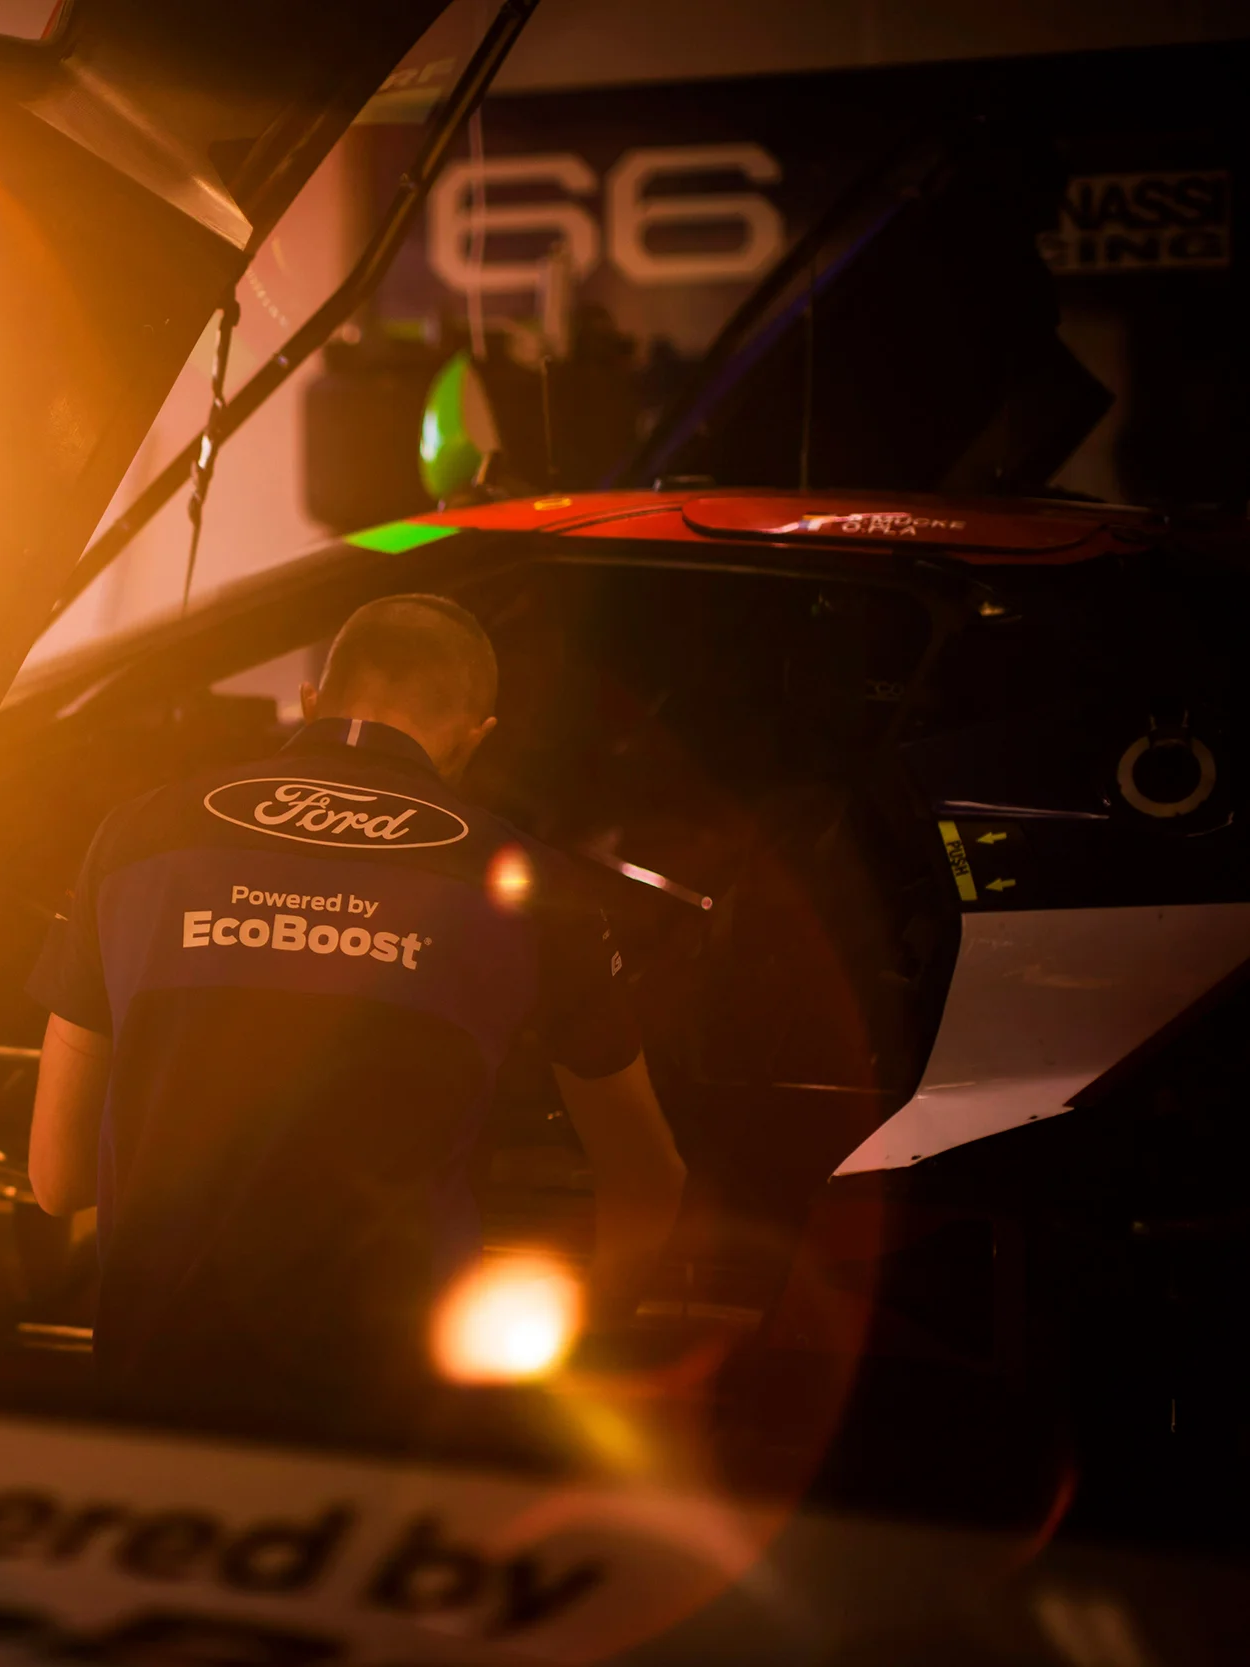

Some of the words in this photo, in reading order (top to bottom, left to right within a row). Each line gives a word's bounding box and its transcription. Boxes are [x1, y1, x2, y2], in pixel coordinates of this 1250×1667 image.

[425, 142, 784, 295] 66
[253, 783, 418, 841] Ford
[945, 840, 970, 877] PUSH
[230, 884, 343, 913] Powered
[347, 894, 380, 919] by
[360, 1505, 612, 1634] by
